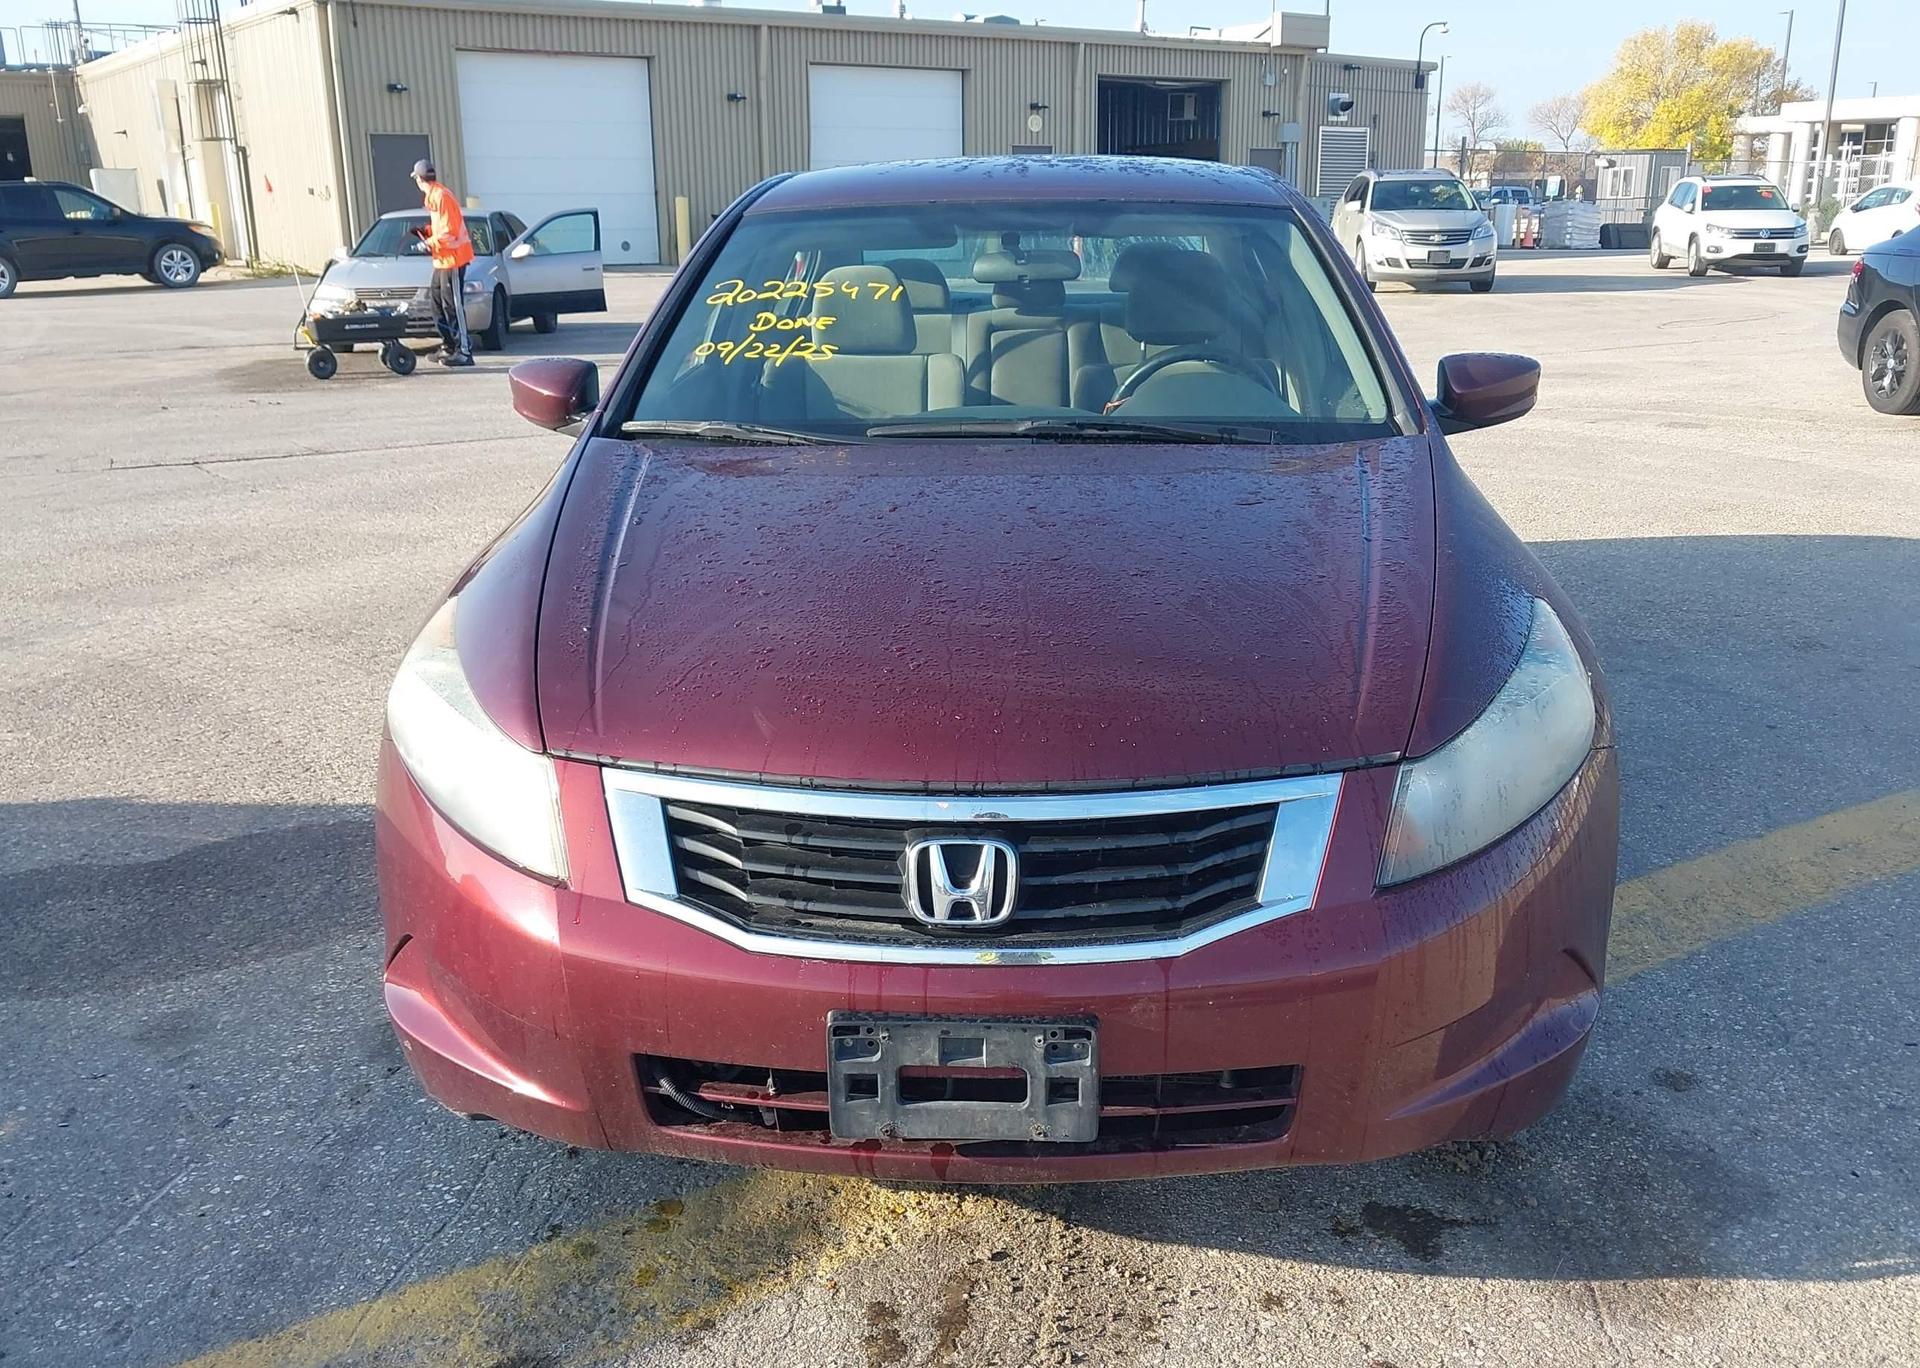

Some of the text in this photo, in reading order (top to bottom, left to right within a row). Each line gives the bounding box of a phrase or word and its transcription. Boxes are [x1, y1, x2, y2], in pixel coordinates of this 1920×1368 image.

[706, 279, 904, 306] 20225471
[749, 312, 837, 332] DONE
[695, 333, 840, 368] 09/22/25
